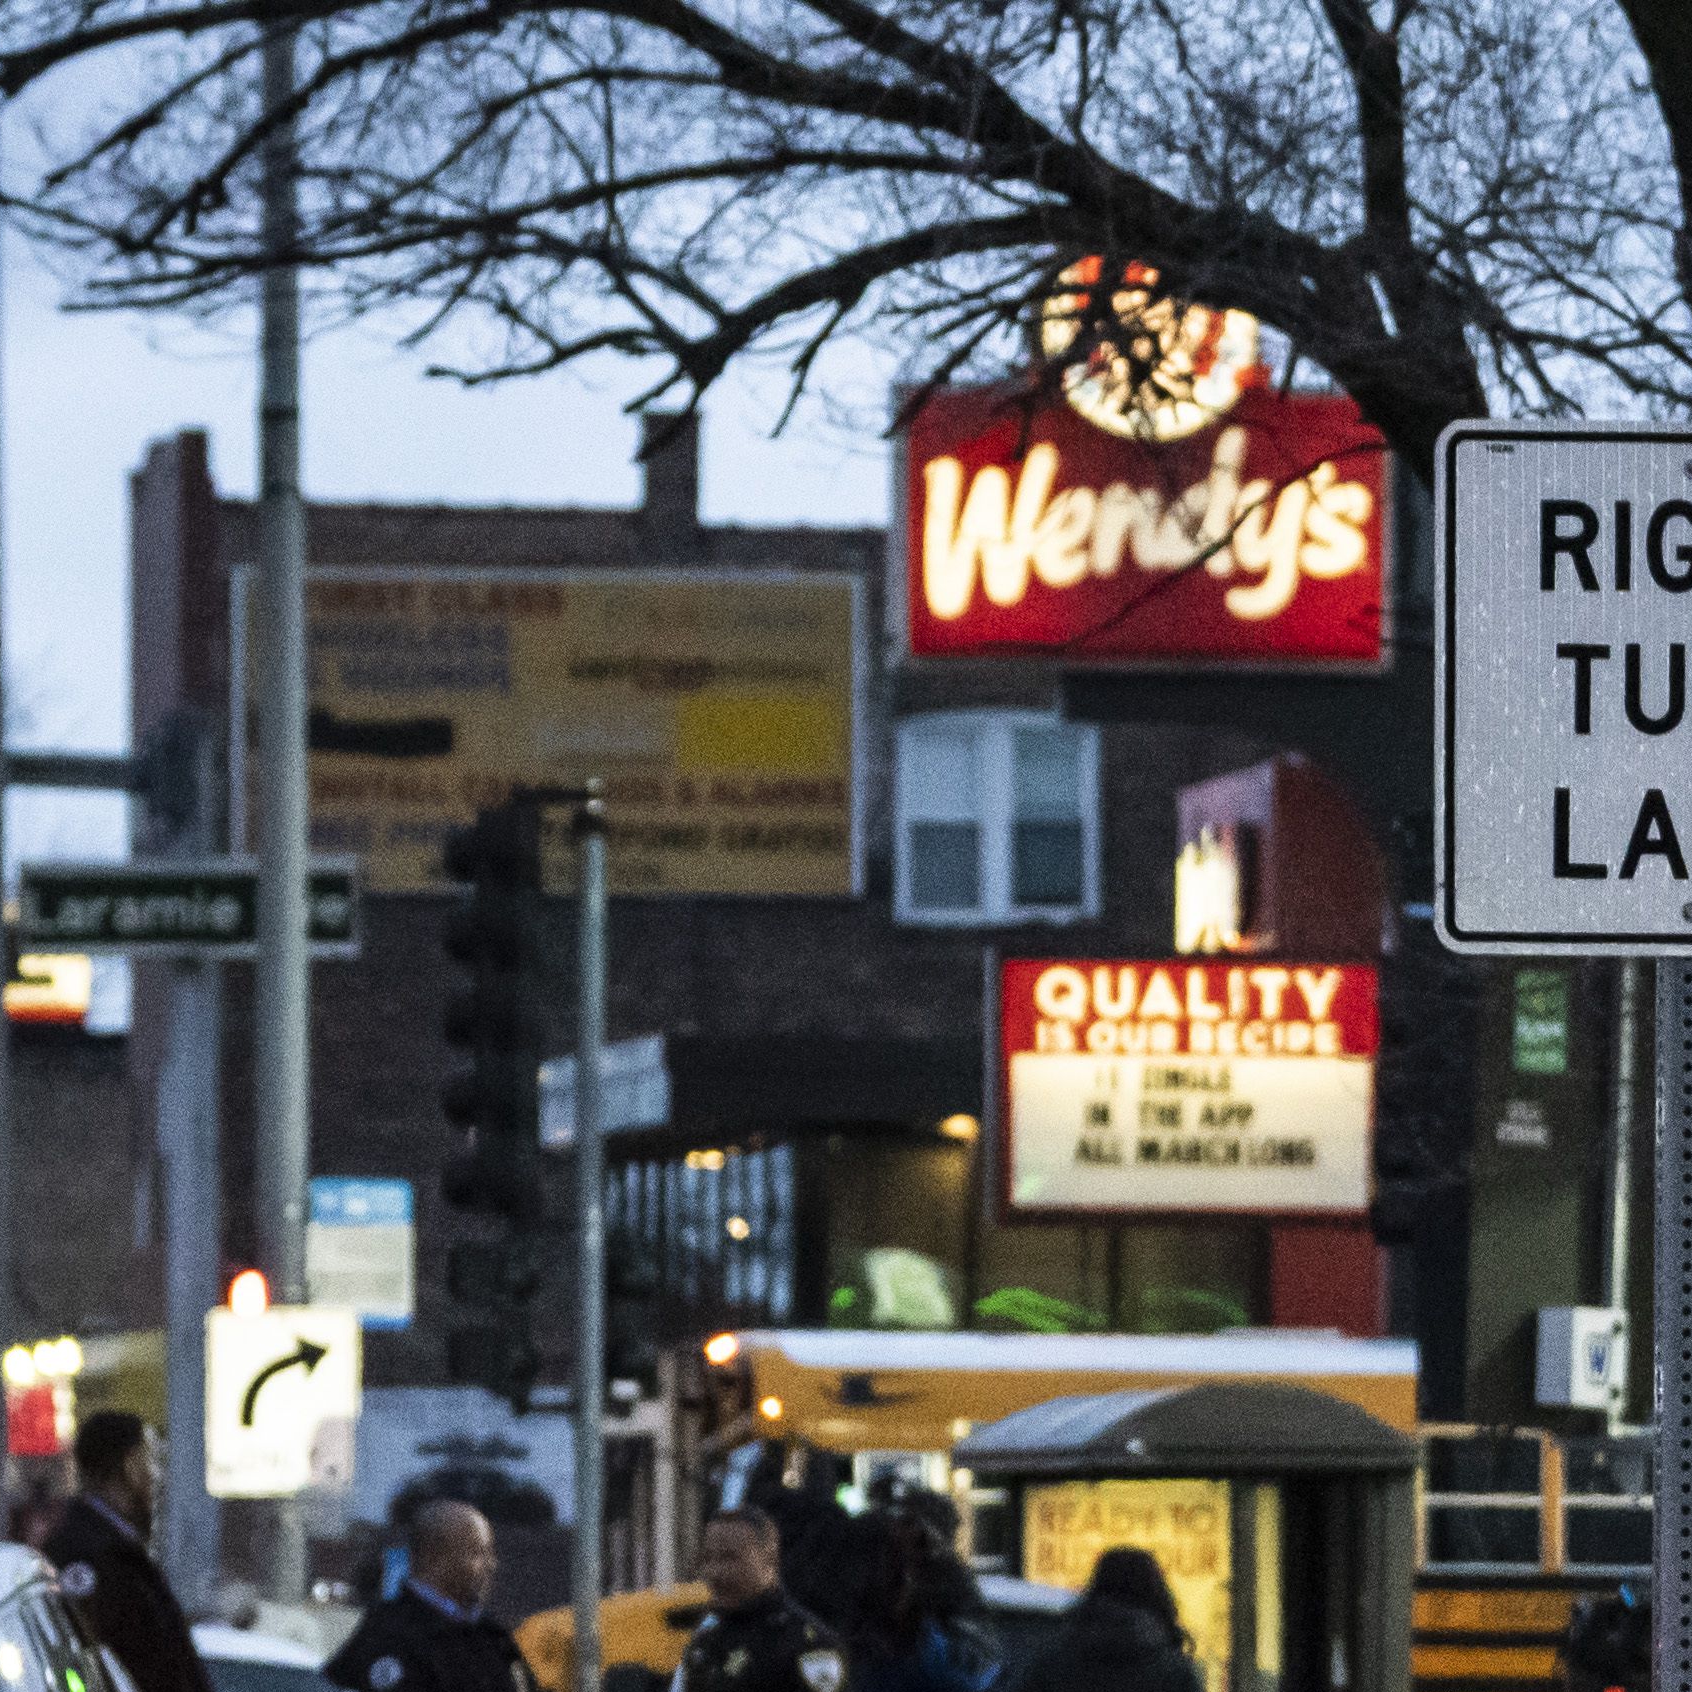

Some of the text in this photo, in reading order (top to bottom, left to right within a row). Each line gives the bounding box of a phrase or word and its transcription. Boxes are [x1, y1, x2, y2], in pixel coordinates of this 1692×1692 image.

[923, 428, 1374, 621] Wendy's
[26, 886, 241, 933] Laramie
[1033, 965, 1343, 1021] QUALITY
[1036, 1021, 1340, 1056] IS OUR RECIPE
[1198, 1102, 1255, 1128] APP
[1074, 1139, 1123, 1167] ALL
[1137, 1139, 1243, 1167] MARCH
